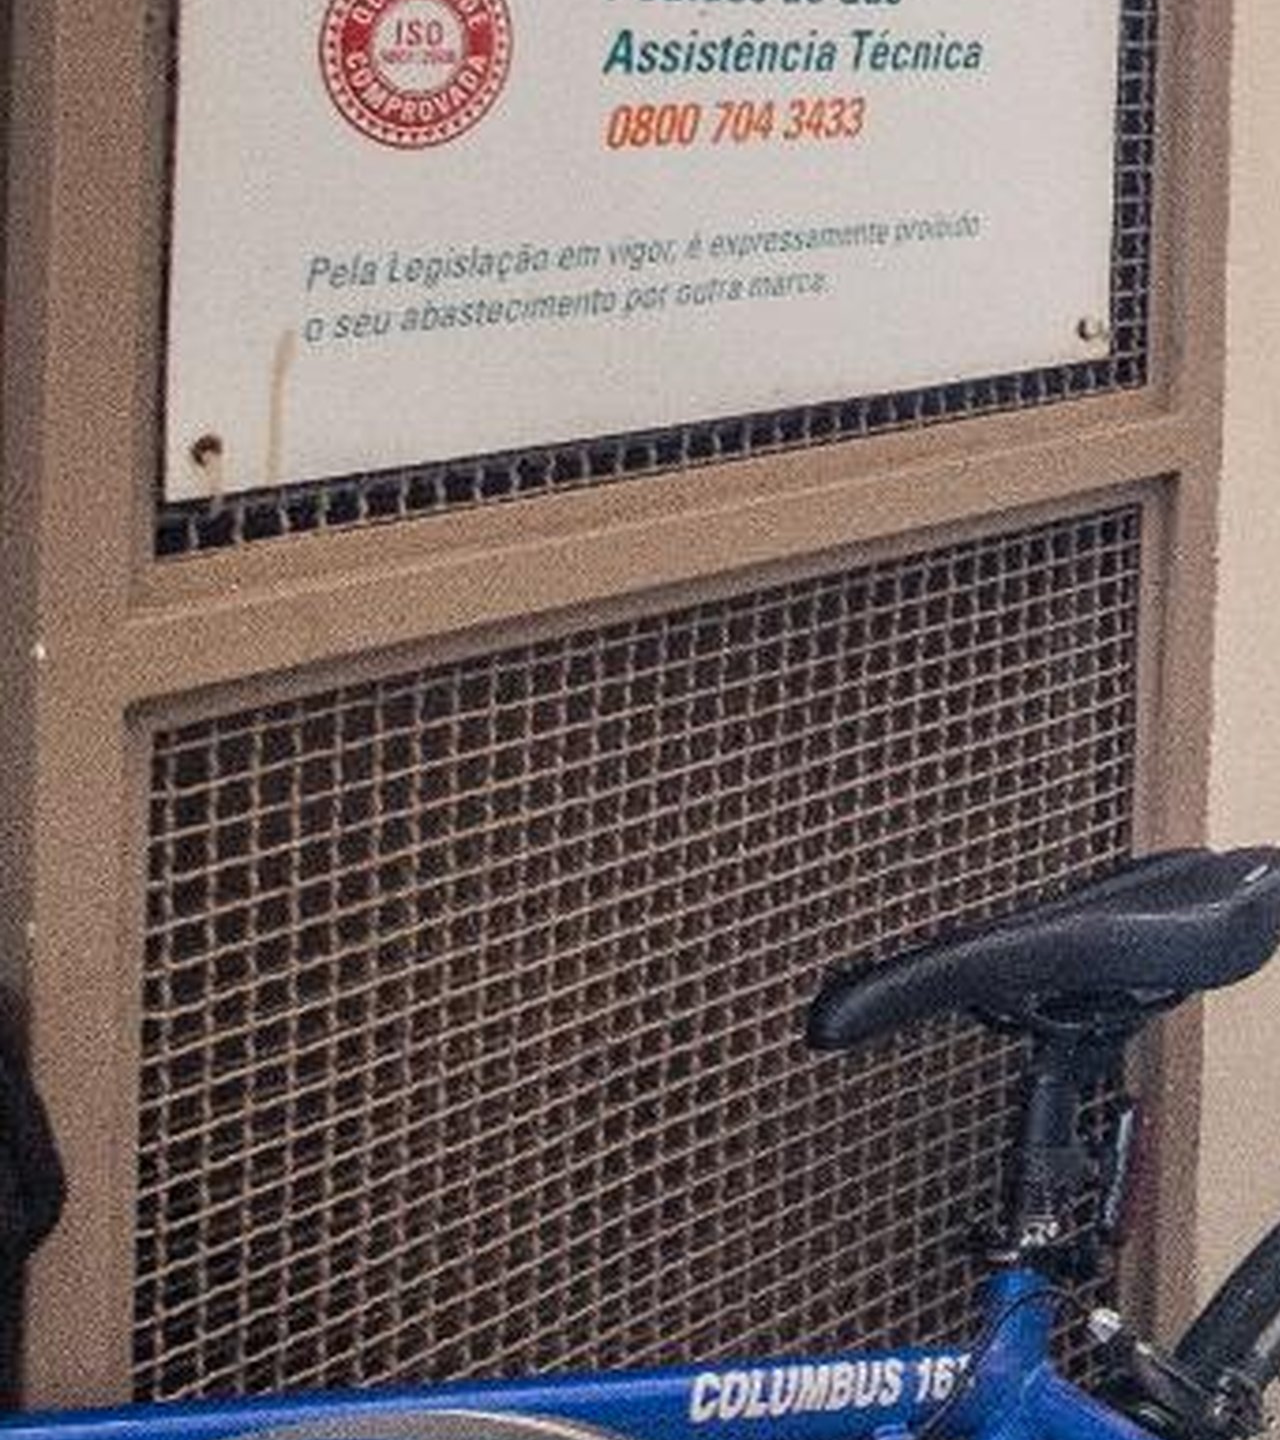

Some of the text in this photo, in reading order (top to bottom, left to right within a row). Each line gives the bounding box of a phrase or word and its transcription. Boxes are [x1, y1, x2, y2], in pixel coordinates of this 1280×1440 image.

[394, 19, 445, 47] ISO
[602, 28, 984, 75] Assistência Técnica
[345, 51, 490, 122] COMPROVADA
[606, 95, 867, 150] 0800 704 3433
[305, 253, 379, 292] Pela
[387, 242, 550, 291] Legislação
[556, 244, 602, 271] em
[304, 316, 324, 343] o
[333, 311, 392, 340] seu
[399, 287, 618, 333] abastecimento
[688, 1357, 906, 1422] COLUMBUS
